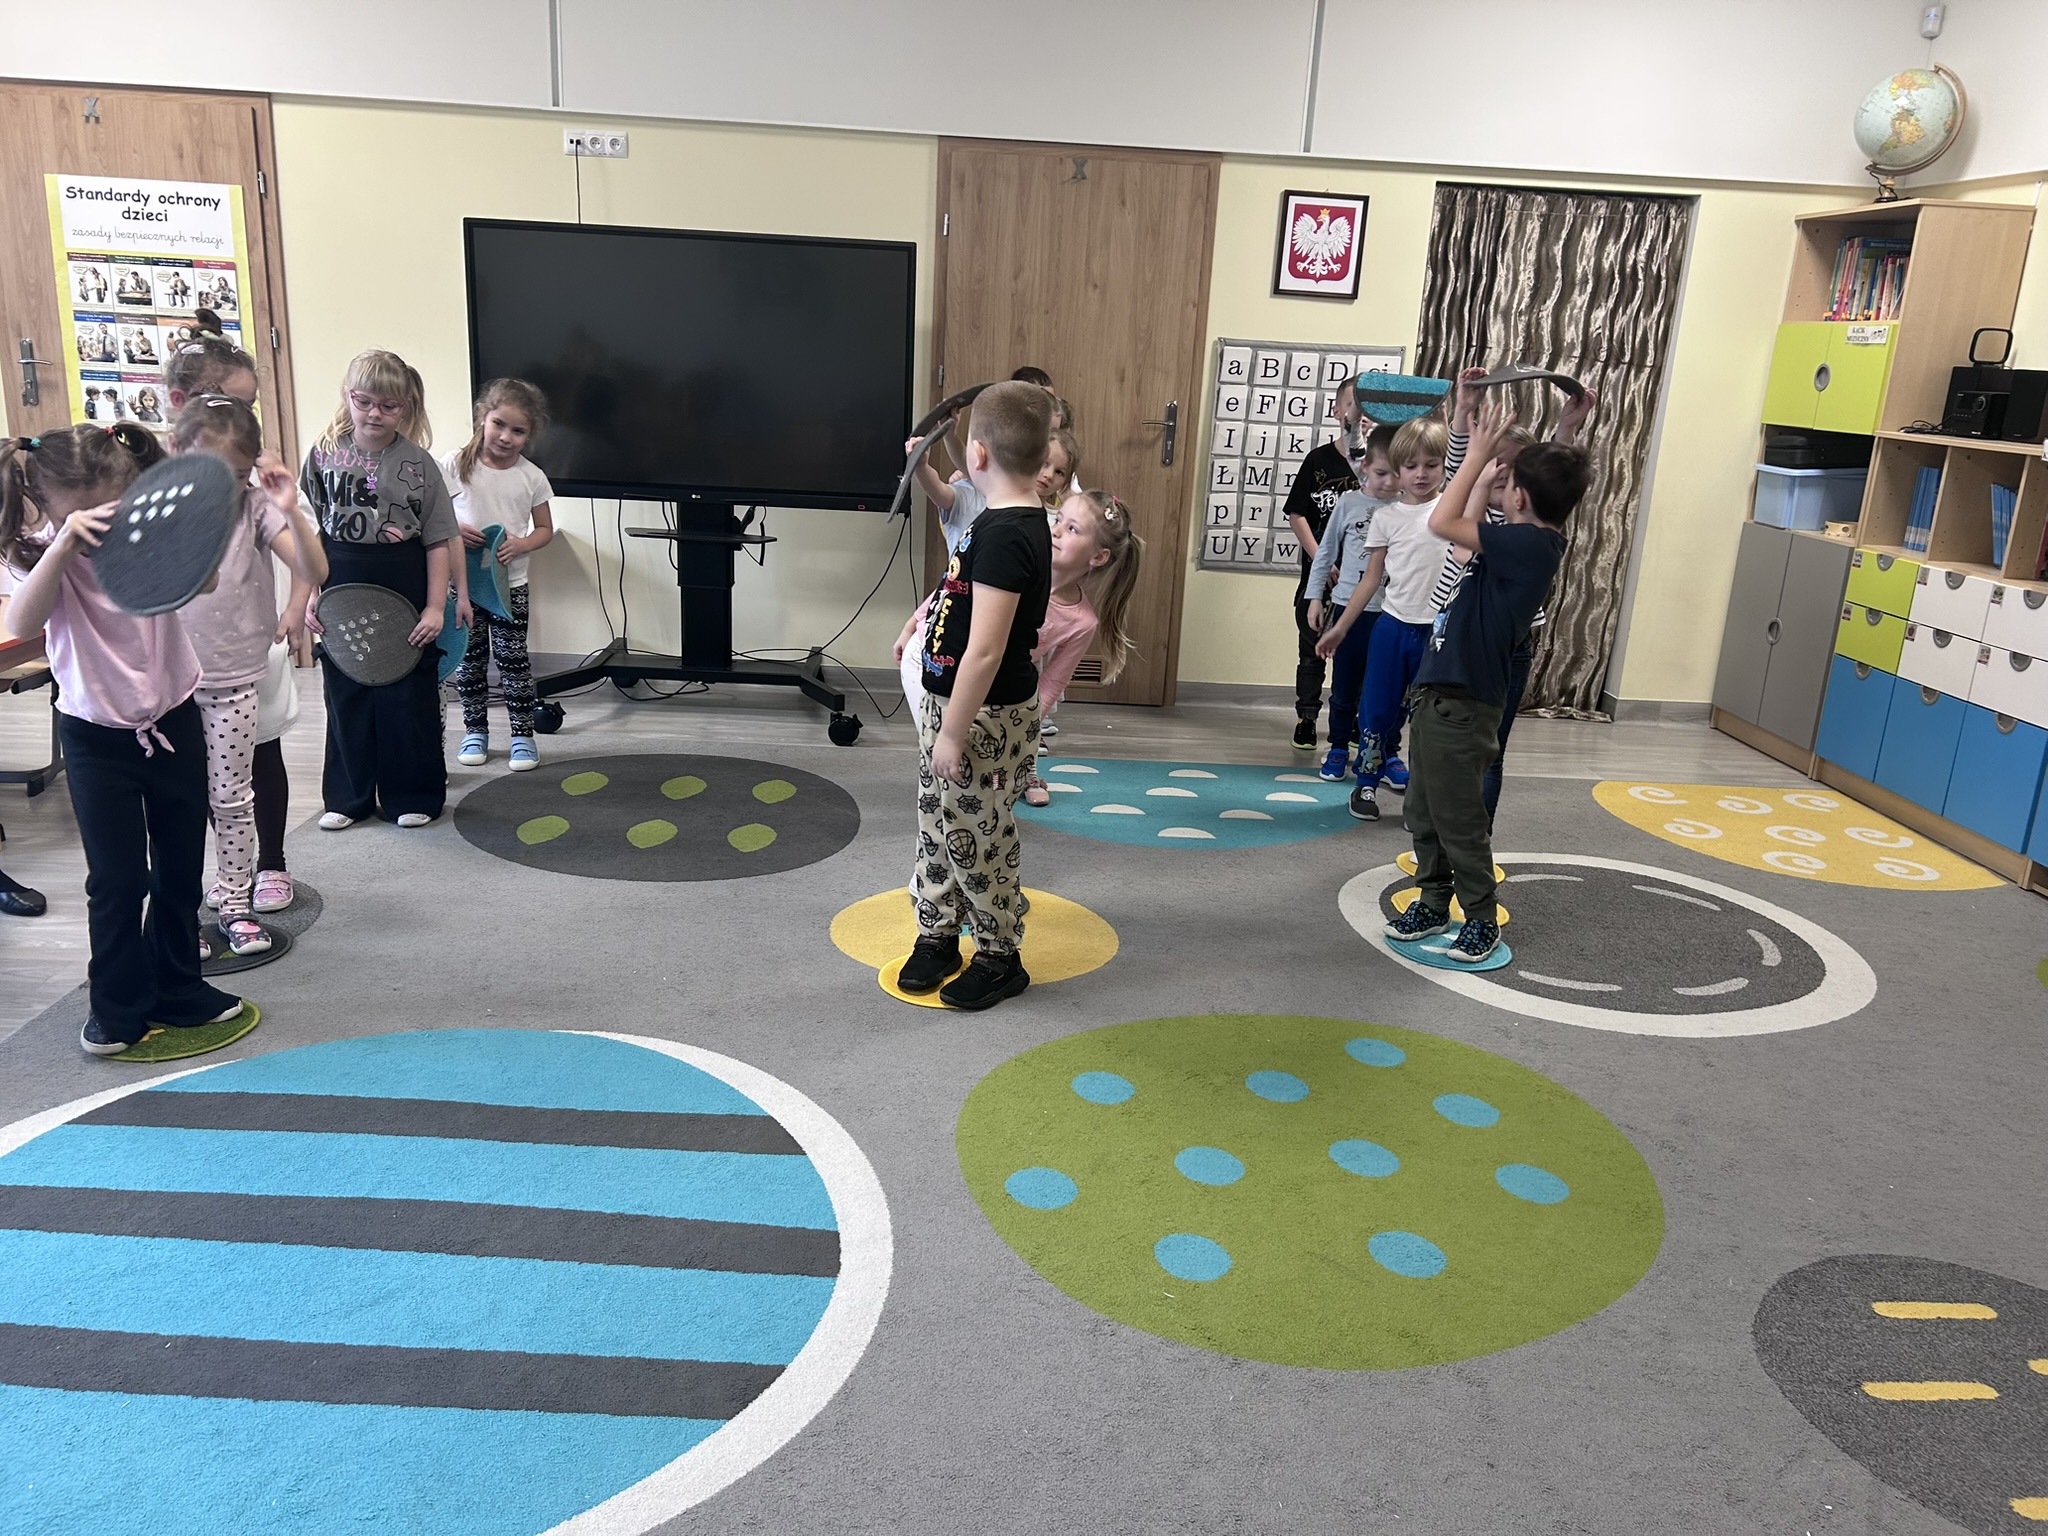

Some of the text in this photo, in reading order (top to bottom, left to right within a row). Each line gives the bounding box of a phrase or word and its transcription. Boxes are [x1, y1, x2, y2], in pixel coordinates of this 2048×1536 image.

[65, 186, 221, 211] Standardy ochrony
[121, 206, 168, 222] dzieci
[72, 226, 224, 249] zasady bezpiecznych relacji
[1228, 360, 1243, 376] a
[1260, 358, 1280, 378] B
[1297, 365, 1311, 380] c
[1327, 361, 1348, 382] D
[1225, 396, 1239, 412] e
[1256, 394, 1276, 415] F
[1287, 396, 1309, 417] G
[1223, 428, 1305, 456] I j k
[1216, 465, 1234, 486] Ł
[1246, 466, 1273, 487] M
[1213, 506, 1229, 525] p
[1248, 506, 1263, 521] r
[1211, 536, 1231, 555] U
[1242, 537, 1261, 556] Y
